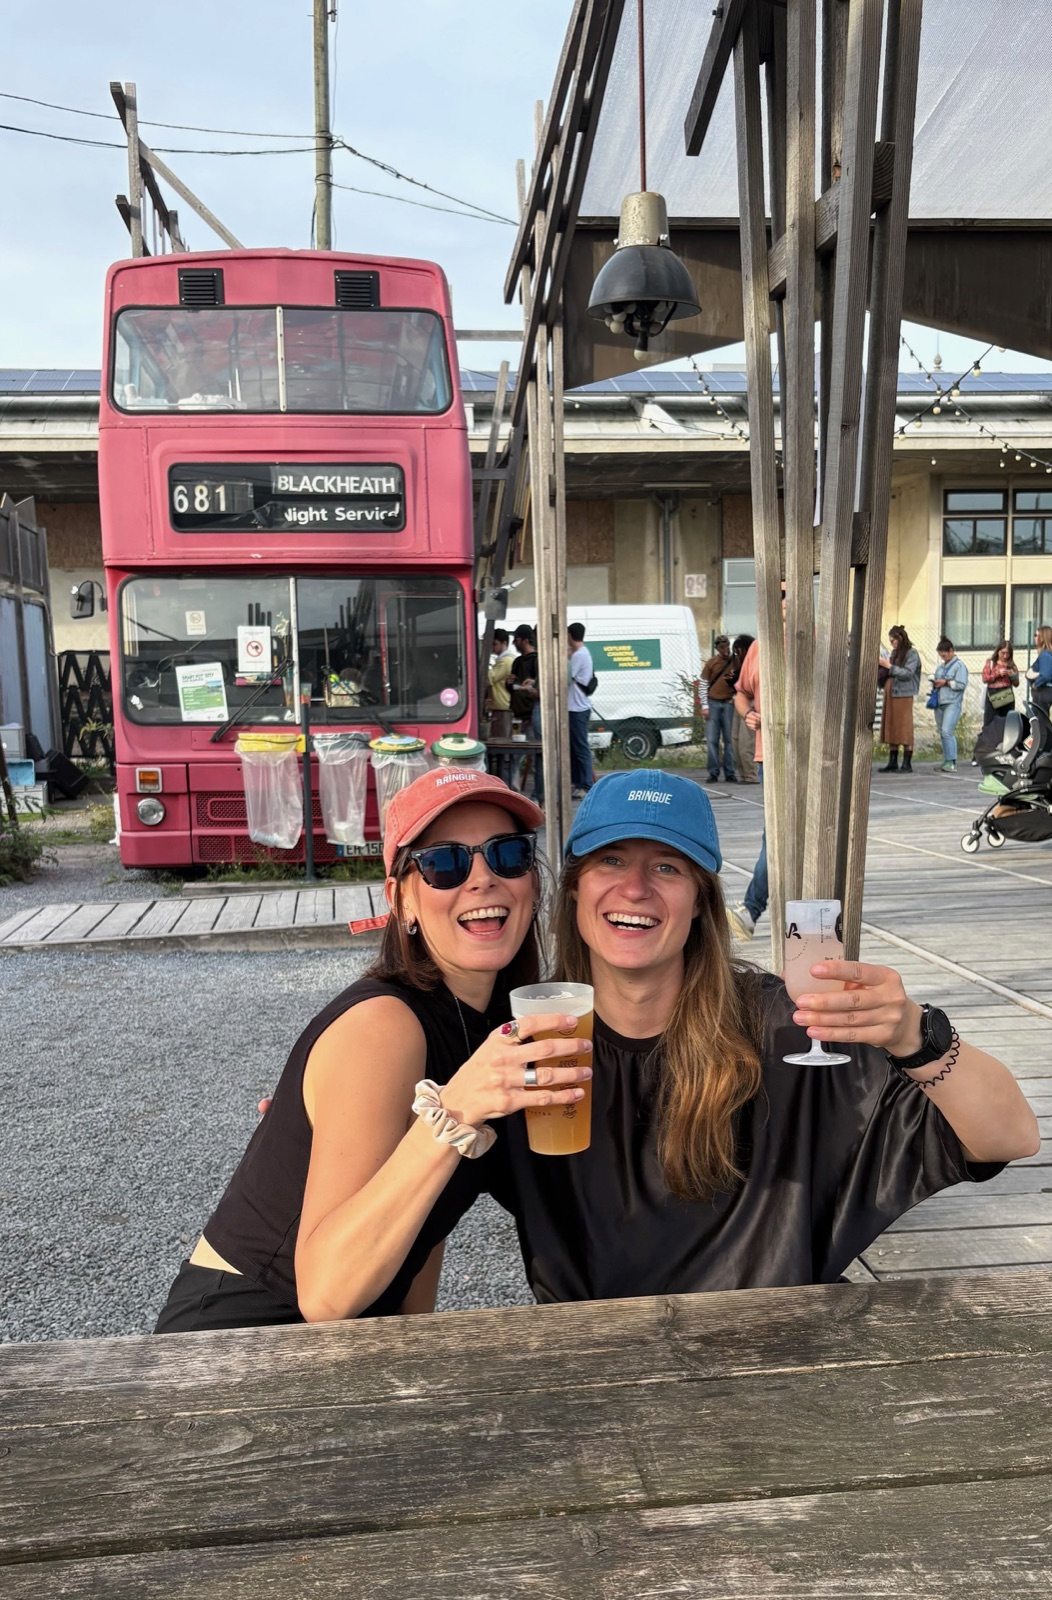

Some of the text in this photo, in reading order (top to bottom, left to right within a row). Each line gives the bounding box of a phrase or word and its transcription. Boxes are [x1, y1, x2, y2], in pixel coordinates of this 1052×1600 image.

[277, 475, 396, 493] BLACKHEATH
[173, 484, 226, 513] 681
[436, 773, 478, 787] BRINGUE
[628, 790, 673, 805] BRINGUE
